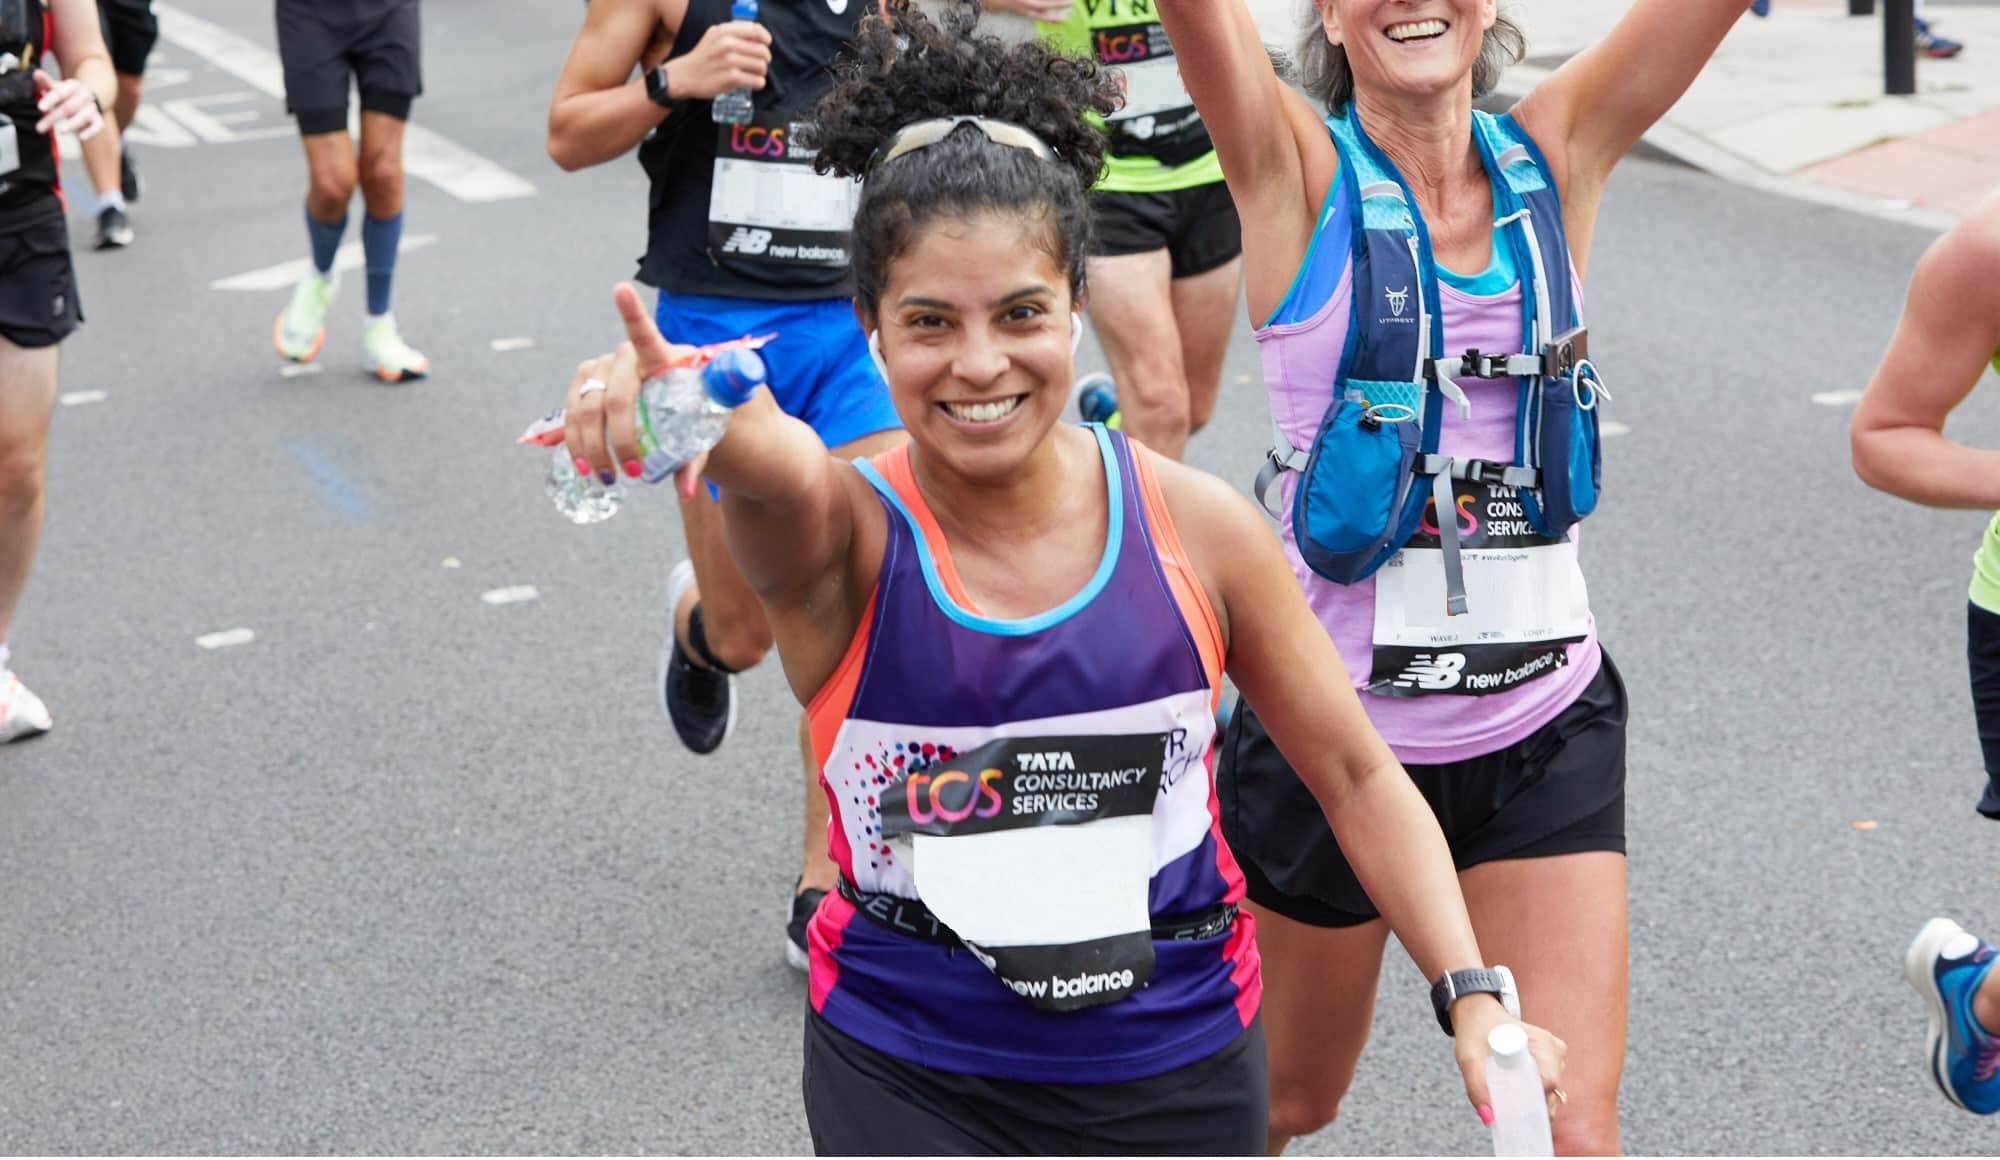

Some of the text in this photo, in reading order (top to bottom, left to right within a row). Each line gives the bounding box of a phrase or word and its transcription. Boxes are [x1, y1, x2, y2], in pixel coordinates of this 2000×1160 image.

[730, 123, 785, 157] tcs
[769, 244, 846, 261] new balance
[1487, 484, 1520, 498] TAT
[1487, 502, 1524, 518] CONS
[1466, 652, 1554, 689] new balance
[1016, 751, 1075, 771] TATA
[1013, 767, 1147, 793] CONSULTANCY
[907, 767, 1003, 824] tcs
[1012, 792, 1099, 816] SERVICES
[1053, 967, 1134, 998] balance
